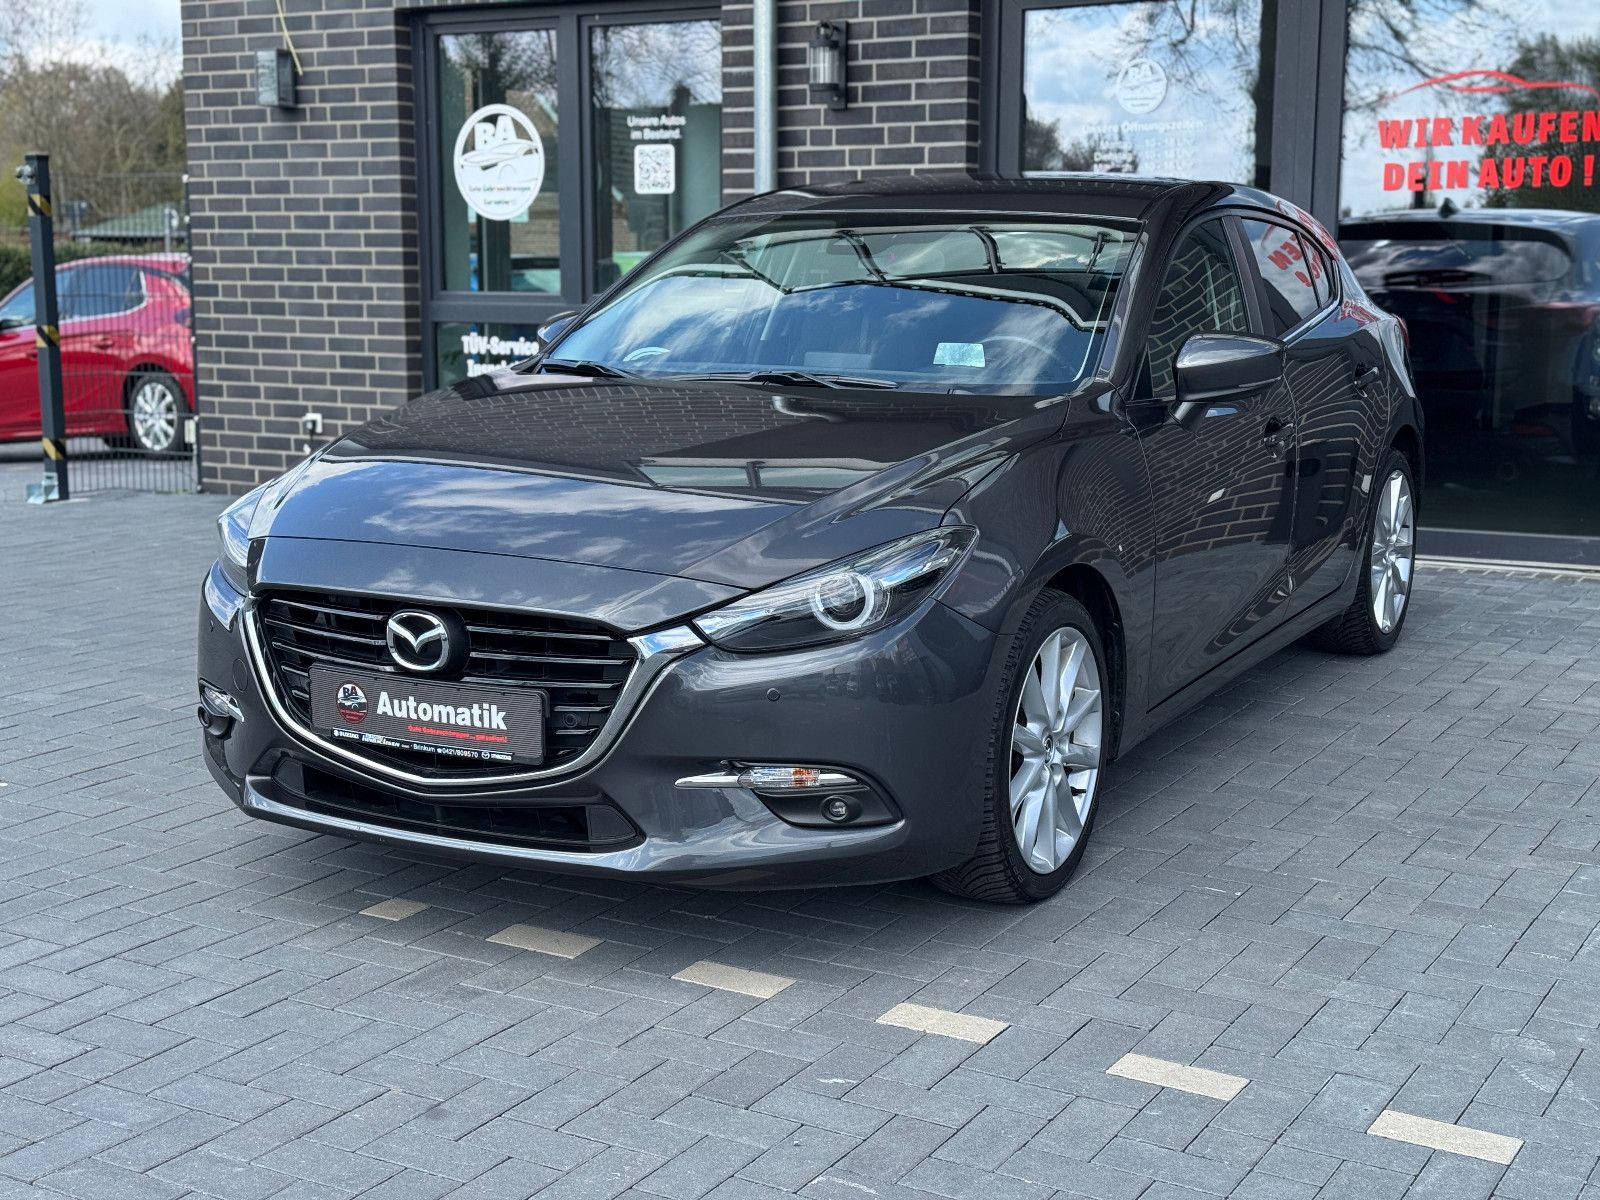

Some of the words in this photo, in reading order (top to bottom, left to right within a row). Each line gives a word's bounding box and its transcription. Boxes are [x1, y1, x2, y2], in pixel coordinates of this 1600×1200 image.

[474, 114, 518, 151] BA
[1378, 117, 1454, 149] WIR
[1462, 110, 1600, 146] KAUFEN
[1384, 159, 1469, 192] DEIN
[1478, 155, 1573, 189] AUTO
[461, 331, 540, 356] TÜV-Service
[342, 685, 358, 698] BA
[376, 691, 508, 730] Automatik
